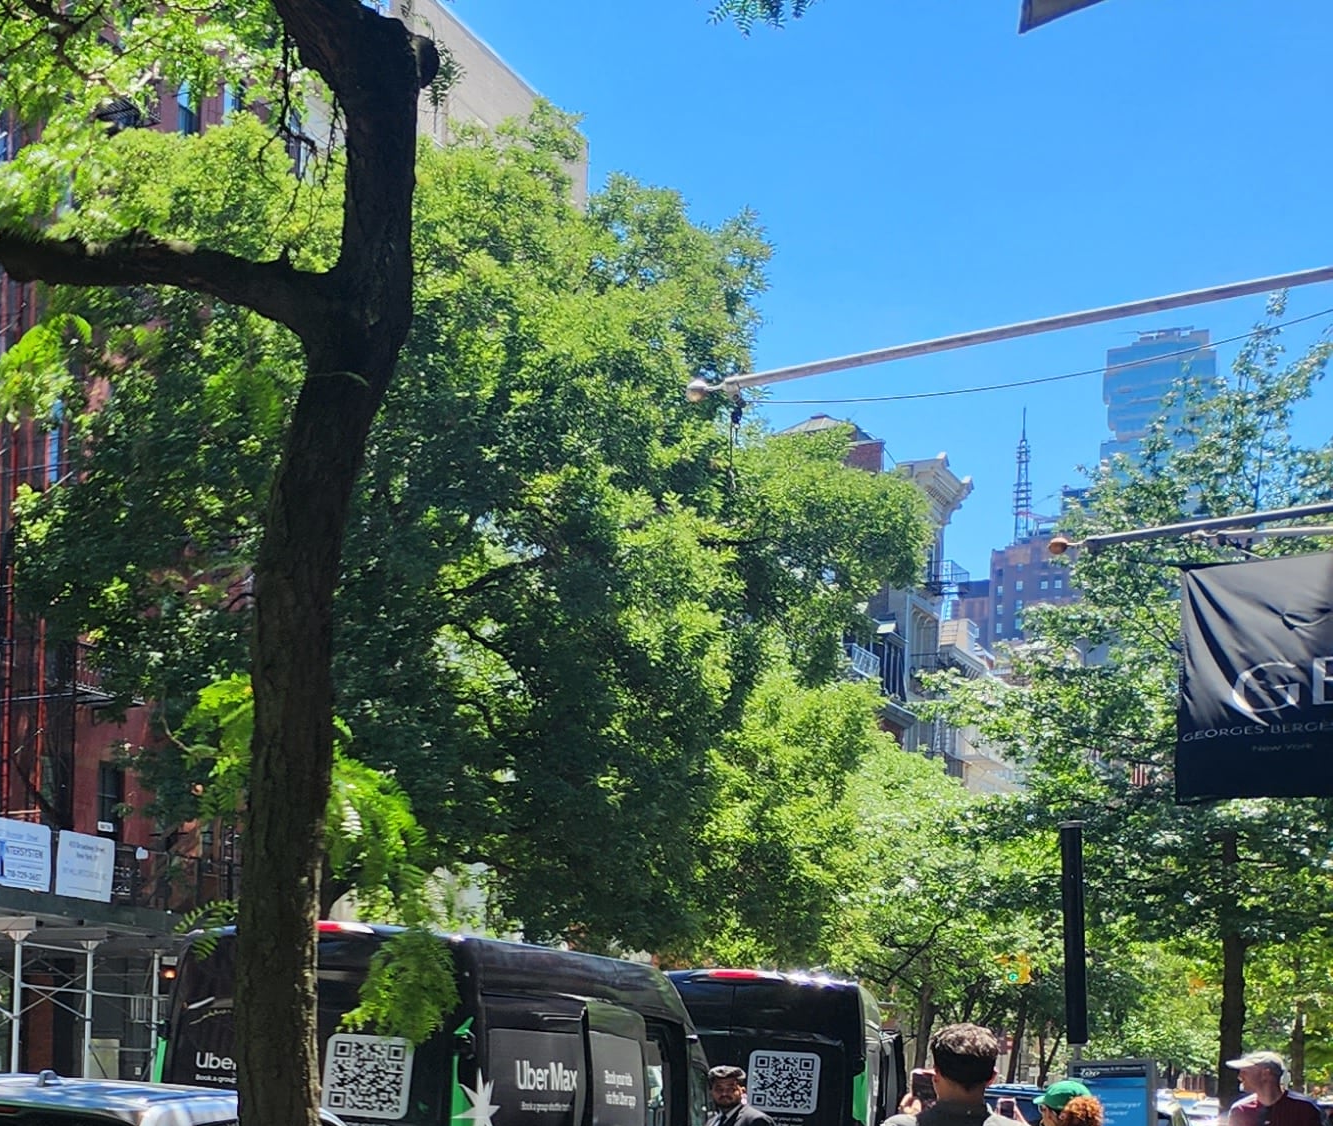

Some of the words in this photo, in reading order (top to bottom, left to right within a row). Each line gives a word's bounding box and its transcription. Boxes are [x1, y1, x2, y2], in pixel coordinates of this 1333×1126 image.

[1182, 725, 1265, 743] GEORGES
[514, 1059, 550, 1091] Uber
[548, 1061, 578, 1092] Max
